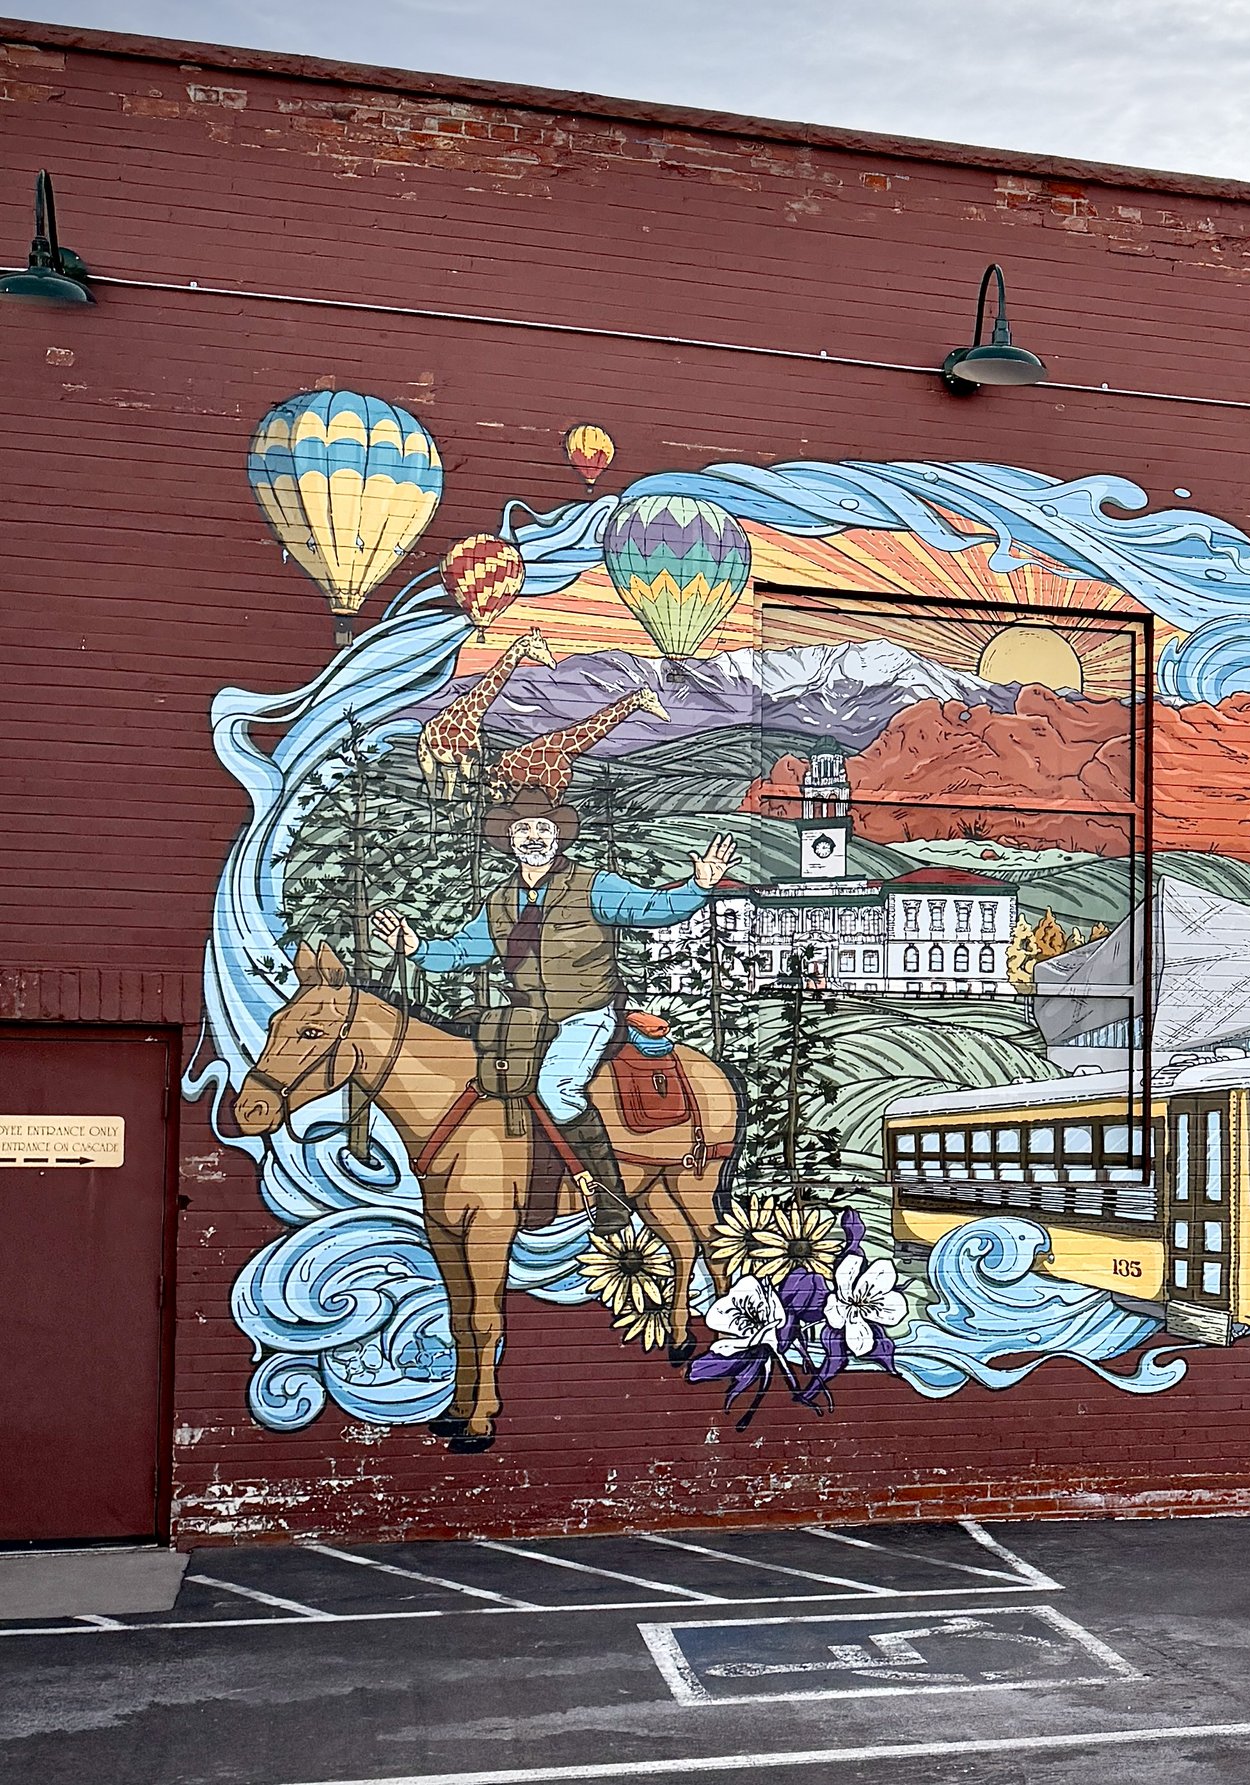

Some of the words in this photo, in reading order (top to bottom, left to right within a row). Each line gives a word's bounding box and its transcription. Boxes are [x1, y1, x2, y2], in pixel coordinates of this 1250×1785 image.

[27, 1126, 85, 1136] ENTRANCE
[89, 1126, 119, 1136] ONLY
[2, 1142, 50, 1152] ENTRANCE
[54, 1142, 69, 1152] ON
[72, 1142, 119, 1152] CASCADE
[1112, 1258, 1142, 1277] 135
